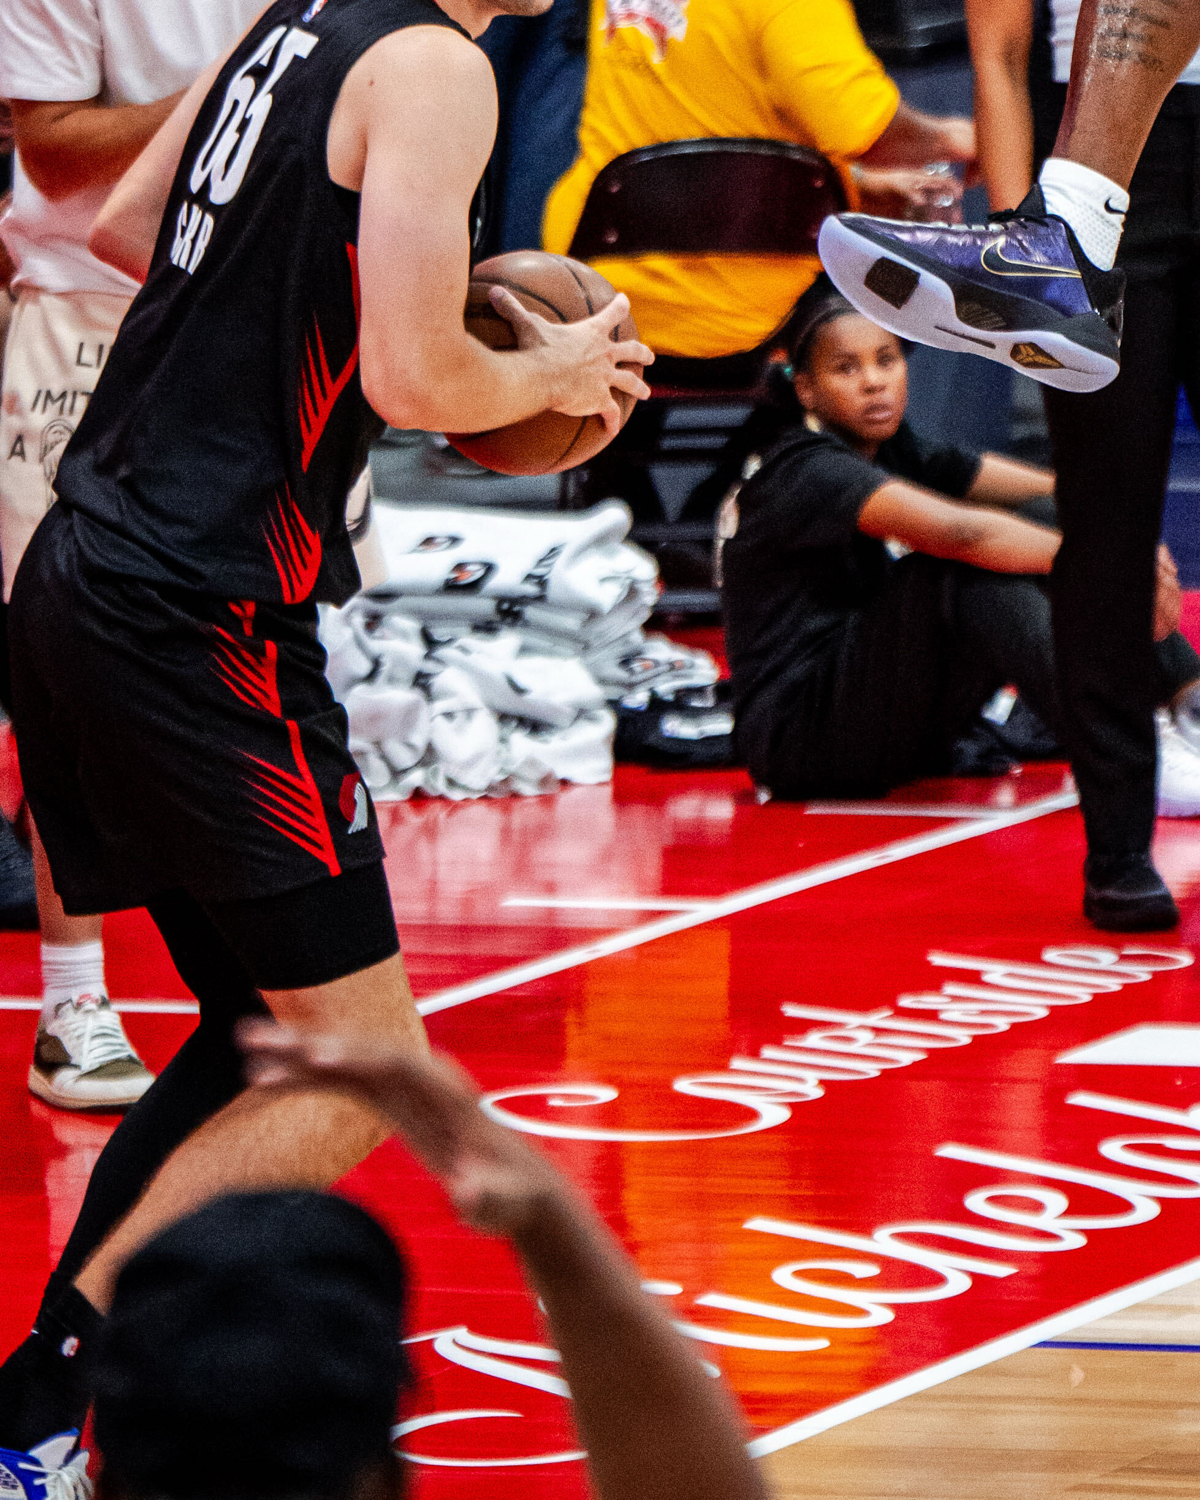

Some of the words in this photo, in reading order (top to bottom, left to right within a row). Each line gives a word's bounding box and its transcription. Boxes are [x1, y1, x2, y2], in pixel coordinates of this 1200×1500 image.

[190, 24, 319, 205] 65
[76, 342, 113, 369] LI
[7, 433, 26, 462] A
[480, 945, 1195, 1141] Courtside
